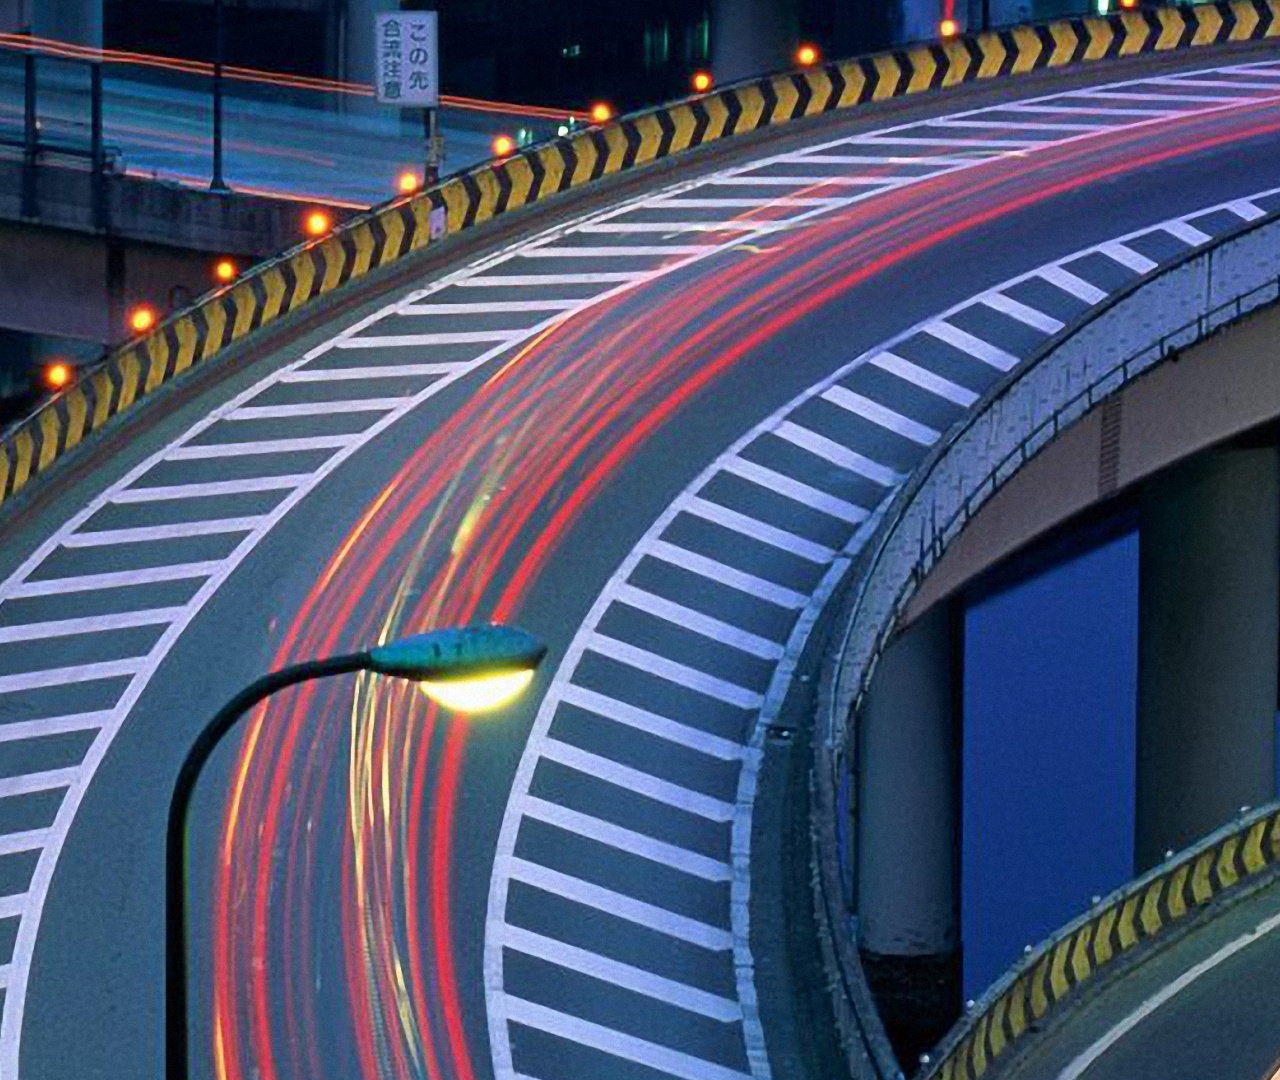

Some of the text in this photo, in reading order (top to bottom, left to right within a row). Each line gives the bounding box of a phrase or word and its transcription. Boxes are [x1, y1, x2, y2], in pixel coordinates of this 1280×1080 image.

[382, 19, 402, 99] 合流注意
[409, 22, 429, 90] この先
